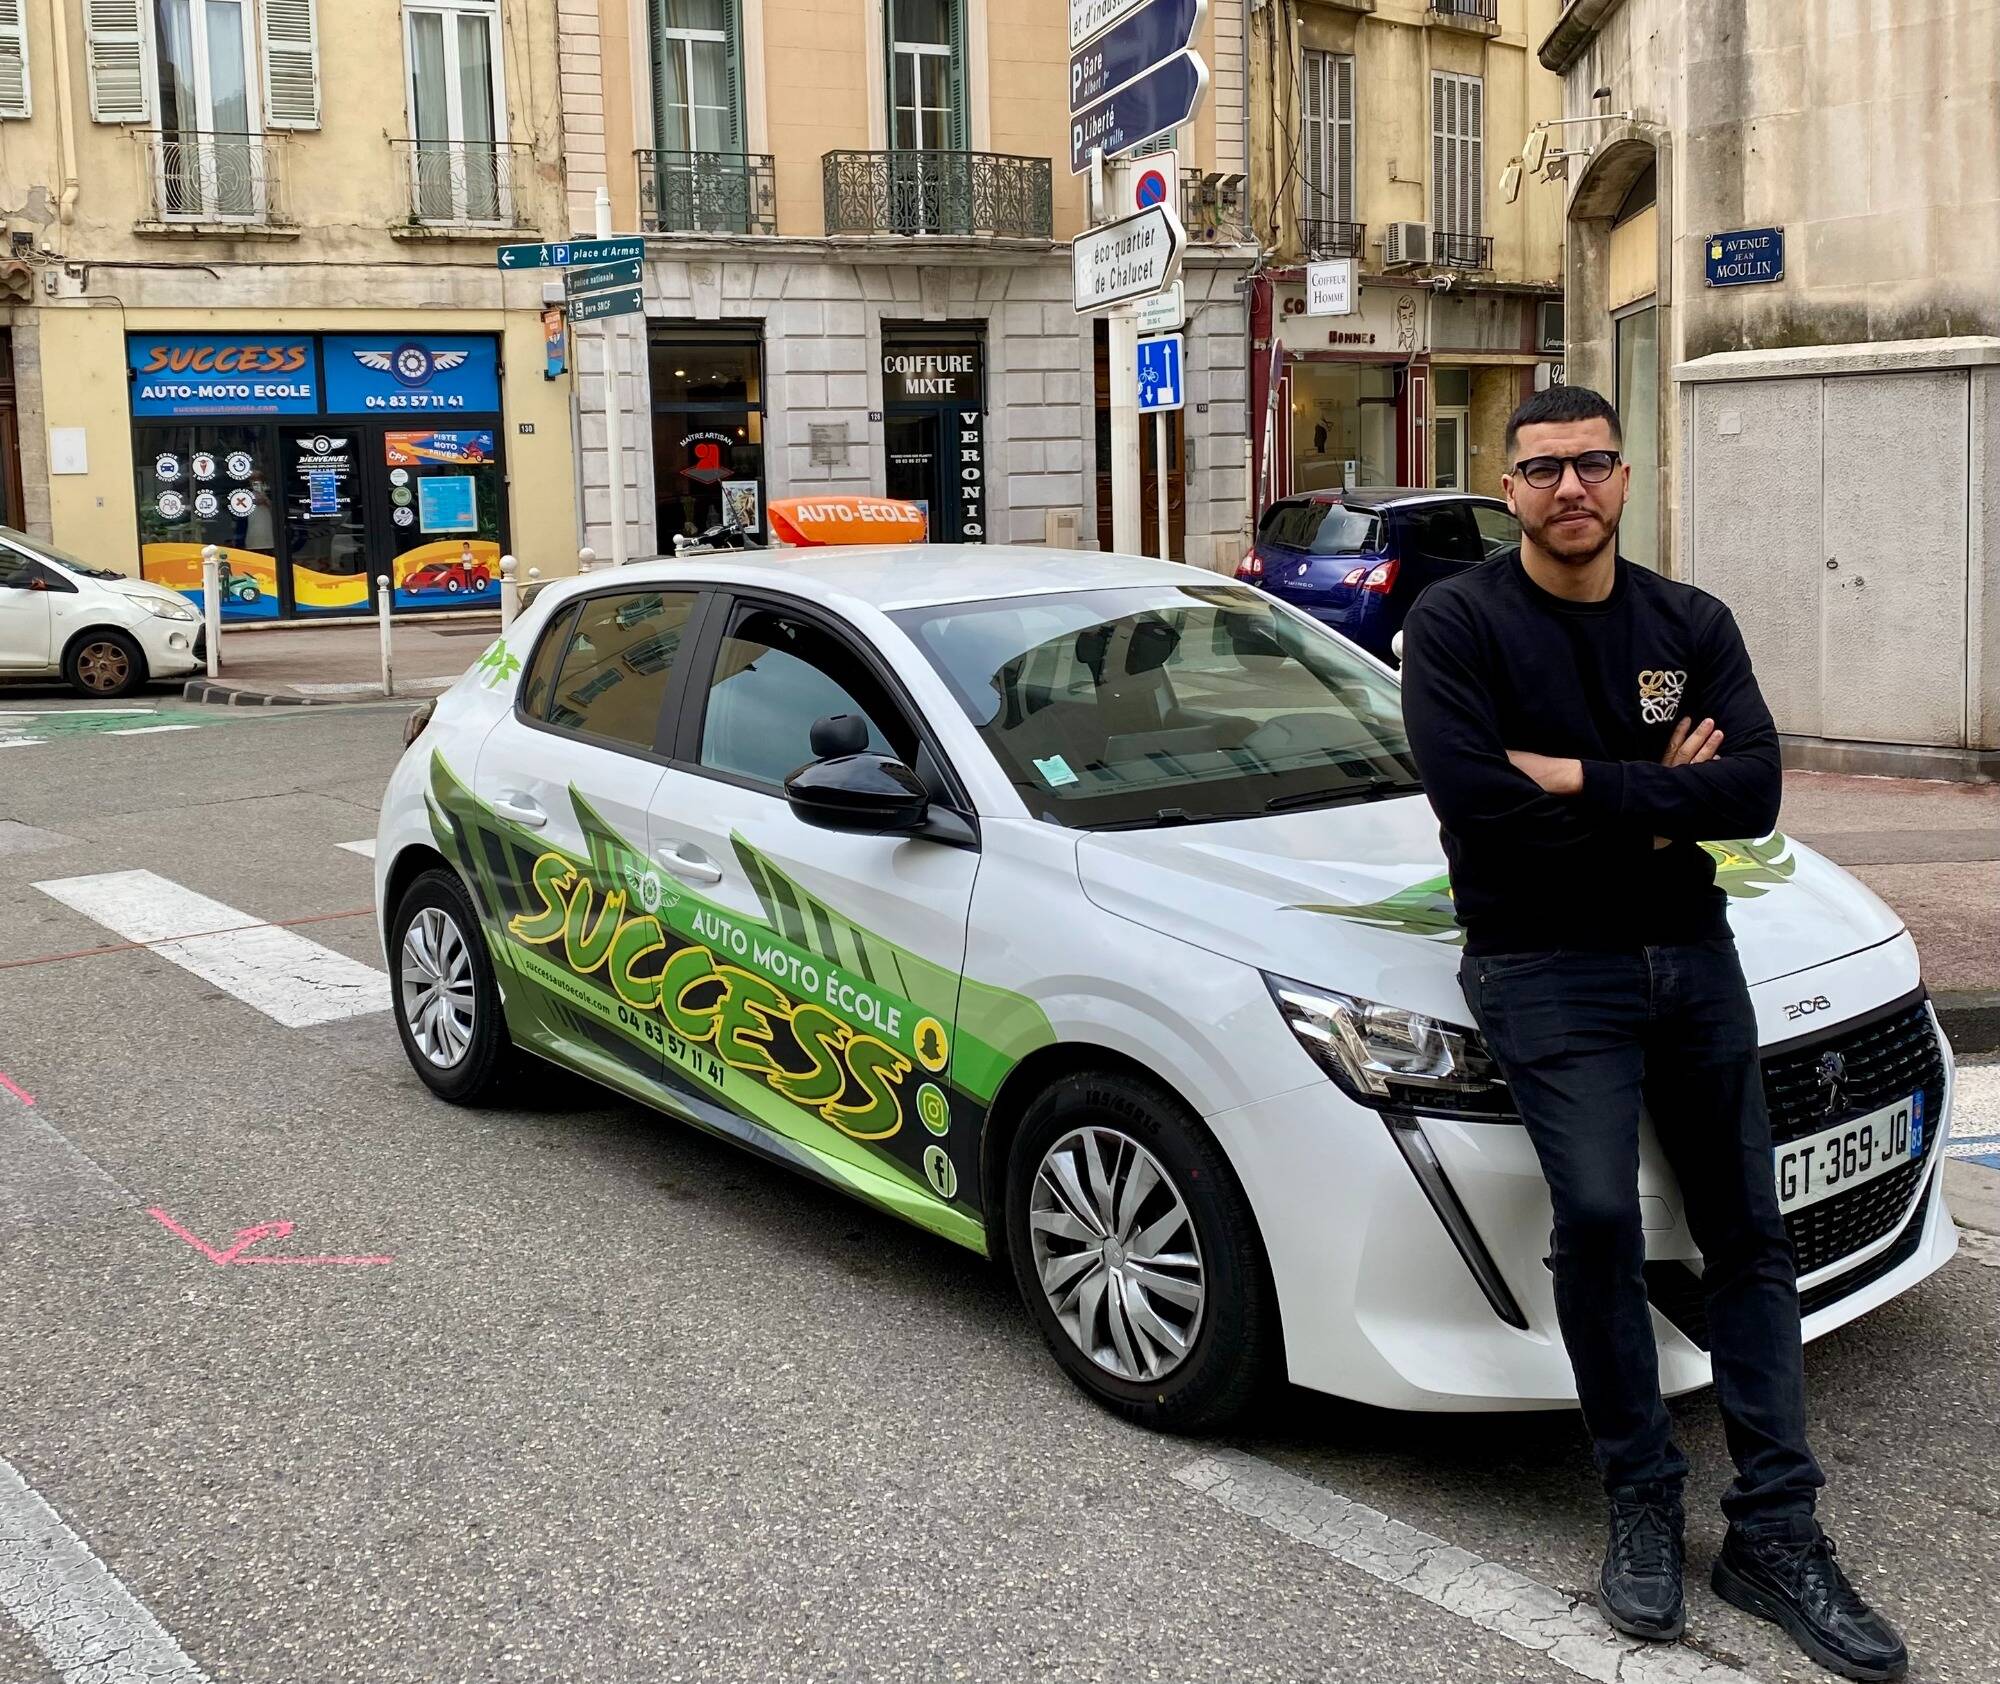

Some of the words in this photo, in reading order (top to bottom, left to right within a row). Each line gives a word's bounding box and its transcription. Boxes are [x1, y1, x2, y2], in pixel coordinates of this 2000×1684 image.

[1083, 52, 1103, 79] Gare
[1084, 104, 1115, 142] Liberté
[1726, 236, 1770, 252] AVENUE
[573, 248, 599, 261] place
[602, 246, 640, 257] d'Armes
[1734, 252, 1754, 261] JEAN
[1095, 272, 1105, 294] de
[1110, 257, 1153, 290] Chalucet
[1716, 260, 1772, 278] MOULIN
[584, 304, 597, 316] gare
[597, 300, 611, 312] SNCF
[142, 345, 307, 373] SUCCESS
[883, 355, 974, 374] COIFFURE
[141, 385, 250, 399] AUTO-MOTO
[254, 384, 311, 398] ECOLE
[905, 378, 956, 394] MIXTE
[365, 396, 386, 408] 04
[389, 396, 407, 407] 83
[410, 396, 428, 407] 57
[432, 396, 444, 406] 11
[448, 395, 464, 407] 41
[433, 433, 458, 442] PISTE
[520, 424, 533, 434] 130
[433, 442, 458, 450] MOTO
[679, 431, 704, 448] MAÎTRE
[704, 431, 734, 447] ARTISAN
[388, 450, 408, 464] CPF
[796, 500, 920, 523] AUTO-ÉCOLE
[1284, 580, 1314, 588] TWINGO
[691, 908, 748, 954] AUTO
[753, 938, 819, 993] MOTO
[825, 969, 902, 1039] ÉCOLE
[508, 852, 912, 1139] SUCCESS
[525, 959, 610, 1015] successautoecole.com
[1782, 995, 1831, 1021] 208
[617, 1005, 640, 1031] 04
[644, 1021, 663, 1047] 83
[668, 1036, 686, 1060] 57
[692, 1049, 702, 1073] 11
[708, 1063, 724, 1088] 41
[1911, 1125, 1923, 1150] 83
